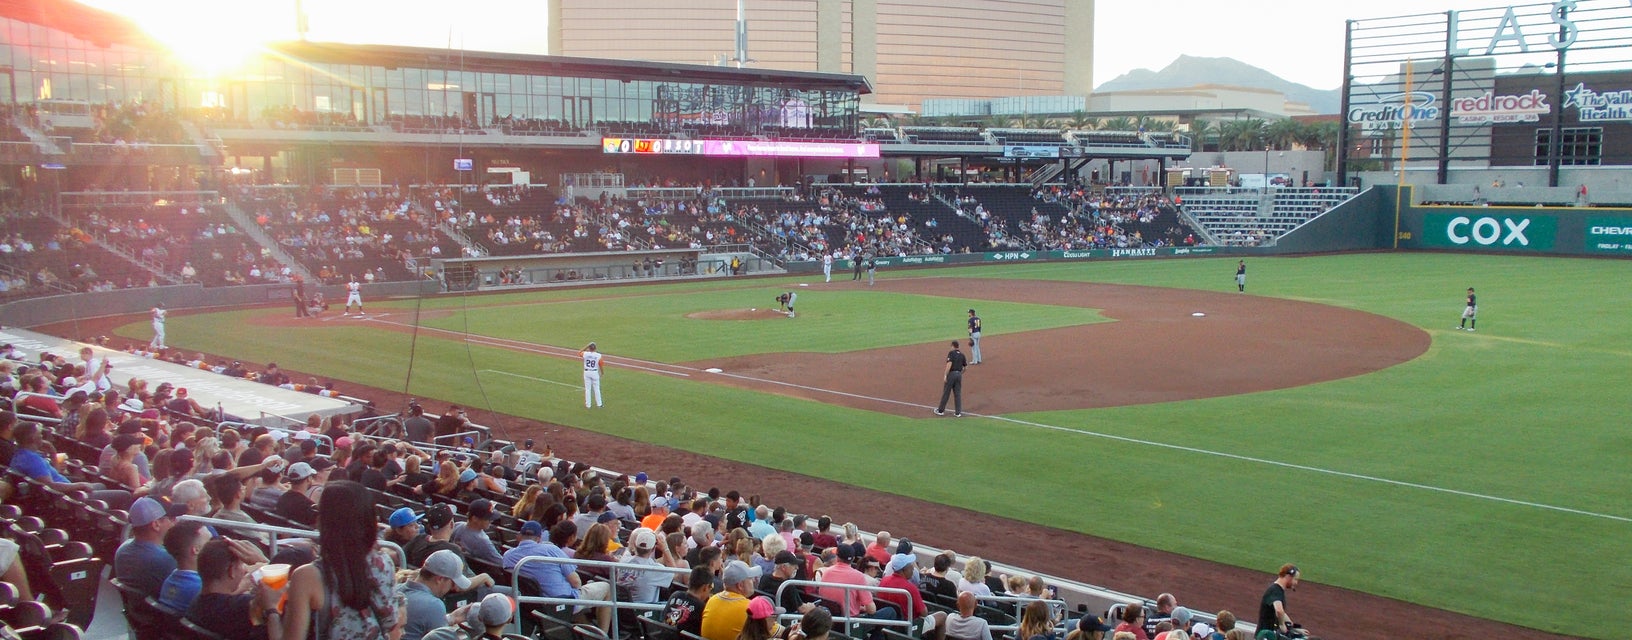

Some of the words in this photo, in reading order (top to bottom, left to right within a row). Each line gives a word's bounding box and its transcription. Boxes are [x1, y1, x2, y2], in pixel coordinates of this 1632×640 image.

[1450, 1, 1578, 55] LAS
[1453, 93, 1489, 111] red
[1495, 90, 1544, 110] rock
[1581, 94, 1604, 105] The
[1582, 107, 1627, 120] Health
[621, 140, 630, 153] 0
[653, 140, 661, 153] 0
[1447, 216, 1530, 246] COX
[1004, 252, 1019, 260] HPN
[586, 359, 596, 368] 28
